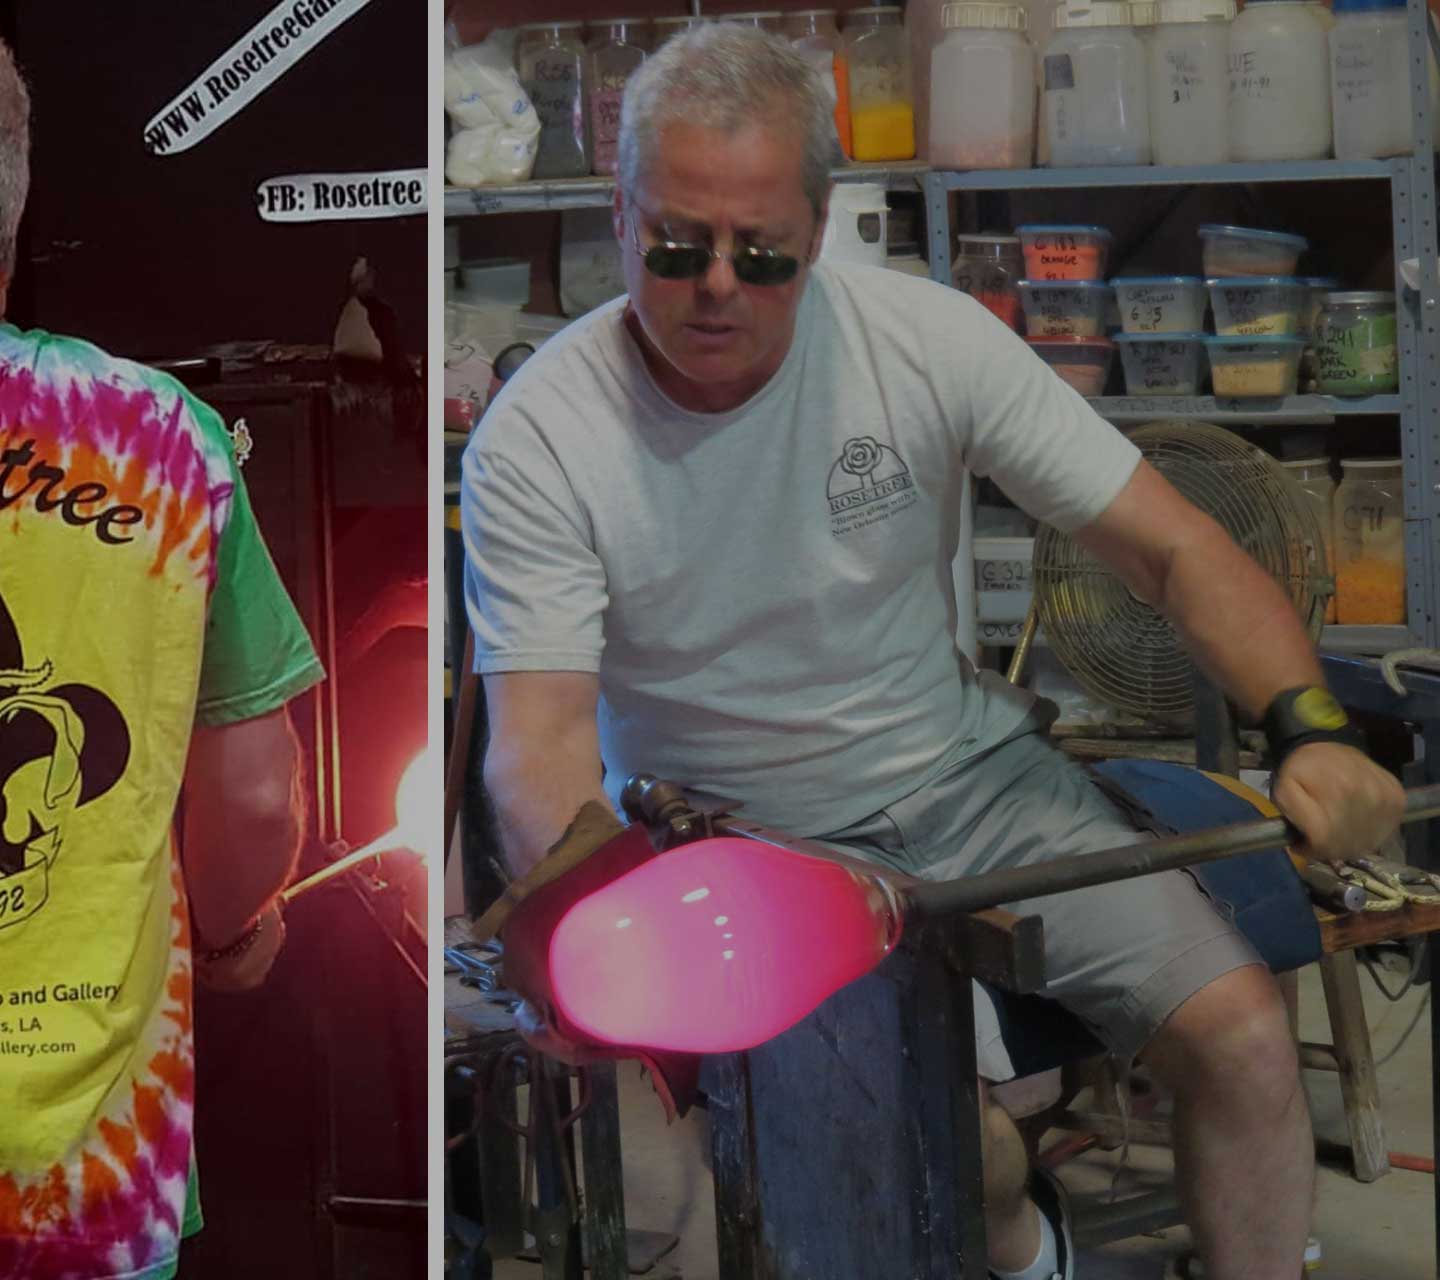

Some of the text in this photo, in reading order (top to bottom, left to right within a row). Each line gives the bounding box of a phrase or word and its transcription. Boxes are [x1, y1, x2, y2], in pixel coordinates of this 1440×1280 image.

[266, 177, 422, 212] FB: Rosetree
[9, 985, 47, 1006] and
[52, 982, 121, 1003] Gallery
[19, 1016, 43, 1033] LA
